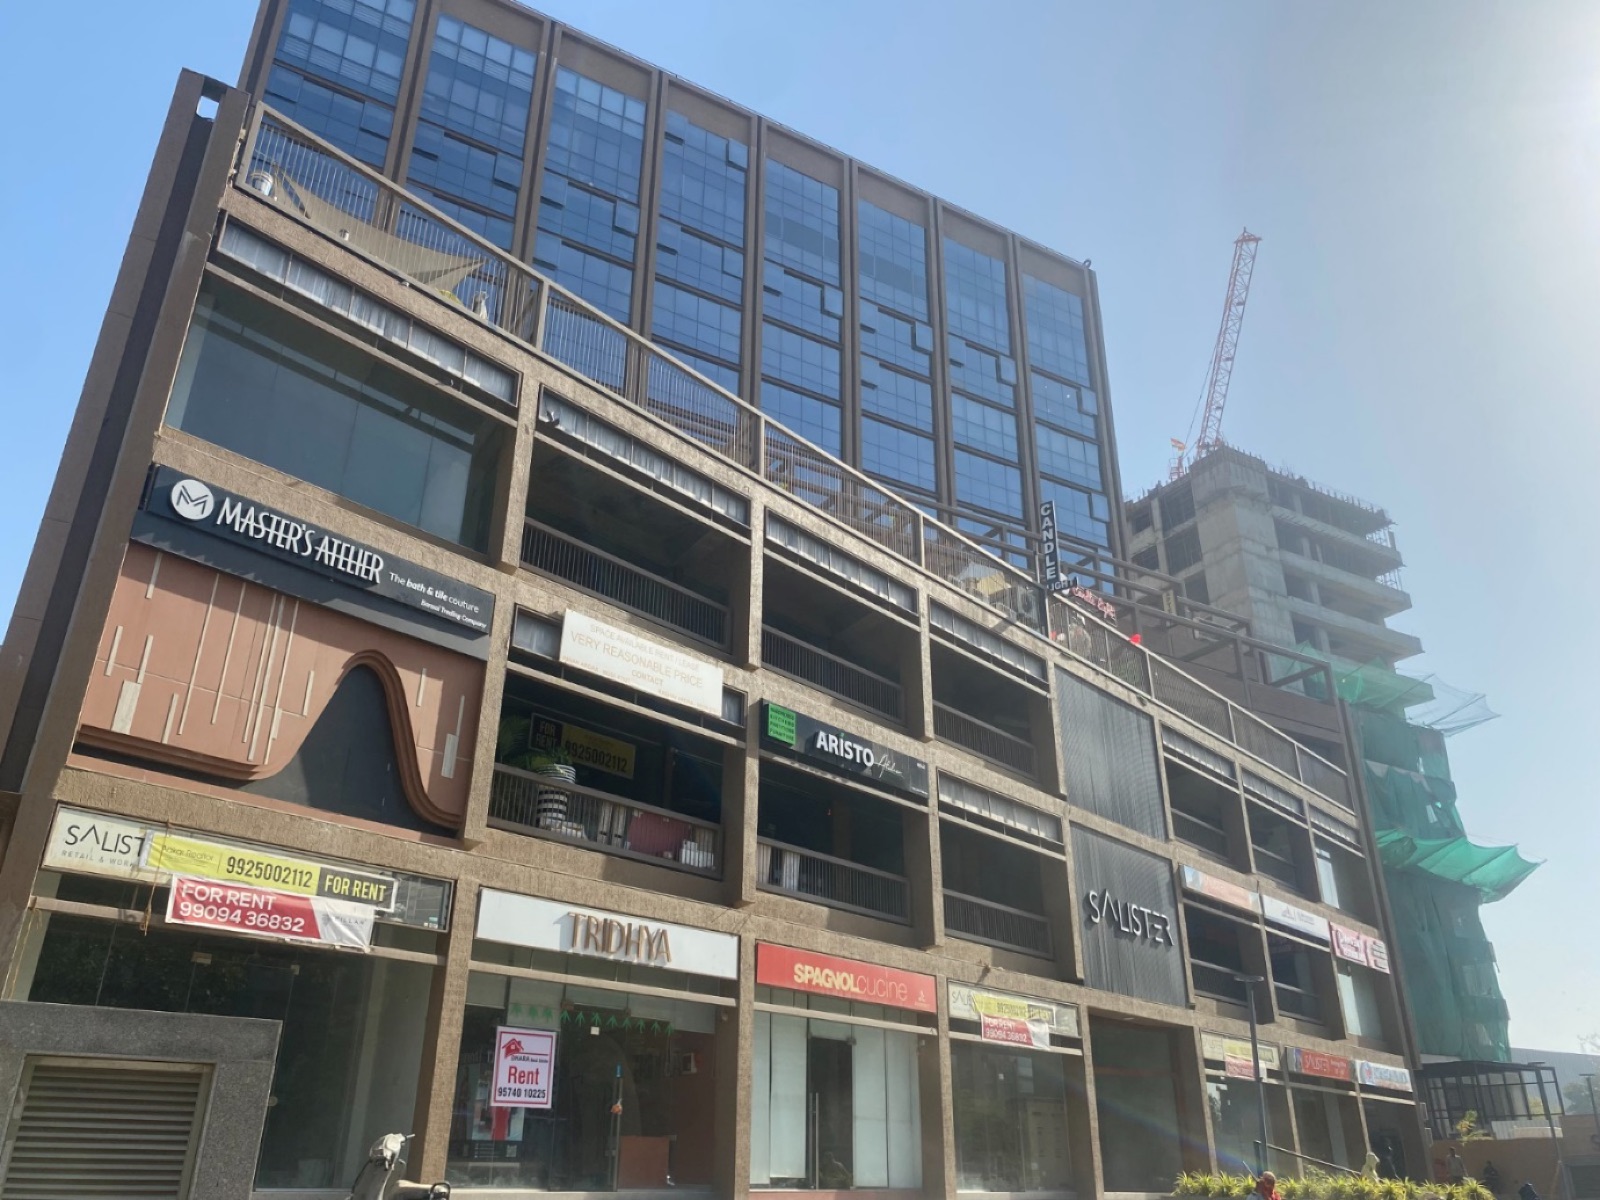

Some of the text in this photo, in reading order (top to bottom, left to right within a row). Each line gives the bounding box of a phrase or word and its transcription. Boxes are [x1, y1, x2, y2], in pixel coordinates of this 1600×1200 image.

[217, 497, 384, 584] MASTER'S ATELIER
[1040, 503, 1057, 580] CANDLE
[390, 570, 480, 613] The bath & tile couture
[441, 605, 461, 621] Trading
[462, 614, 487, 629] Company
[570, 630, 600, 651] VERY
[603, 643, 671, 678] REASONABLE
[674, 669, 704, 689] PRICE
[631, 669, 664, 686] CONTACT
[539, 720, 556, 737] FOR
[816, 729, 875, 767] ARISTO
[61, 849, 94, 862] RETAIL
[226, 855, 313, 889] 9925002112
[324, 873, 386, 902] FOR RENT
[181, 884, 277, 911] FOR RENT
[179, 901, 305, 933] 99094 36832
[1089, 889, 1175, 946] SALISTER
[568, 911, 672, 963] TRIDHYA
[508, 1066, 540, 1085] Rent
[498, 1086, 546, 1099] 95740 10225
